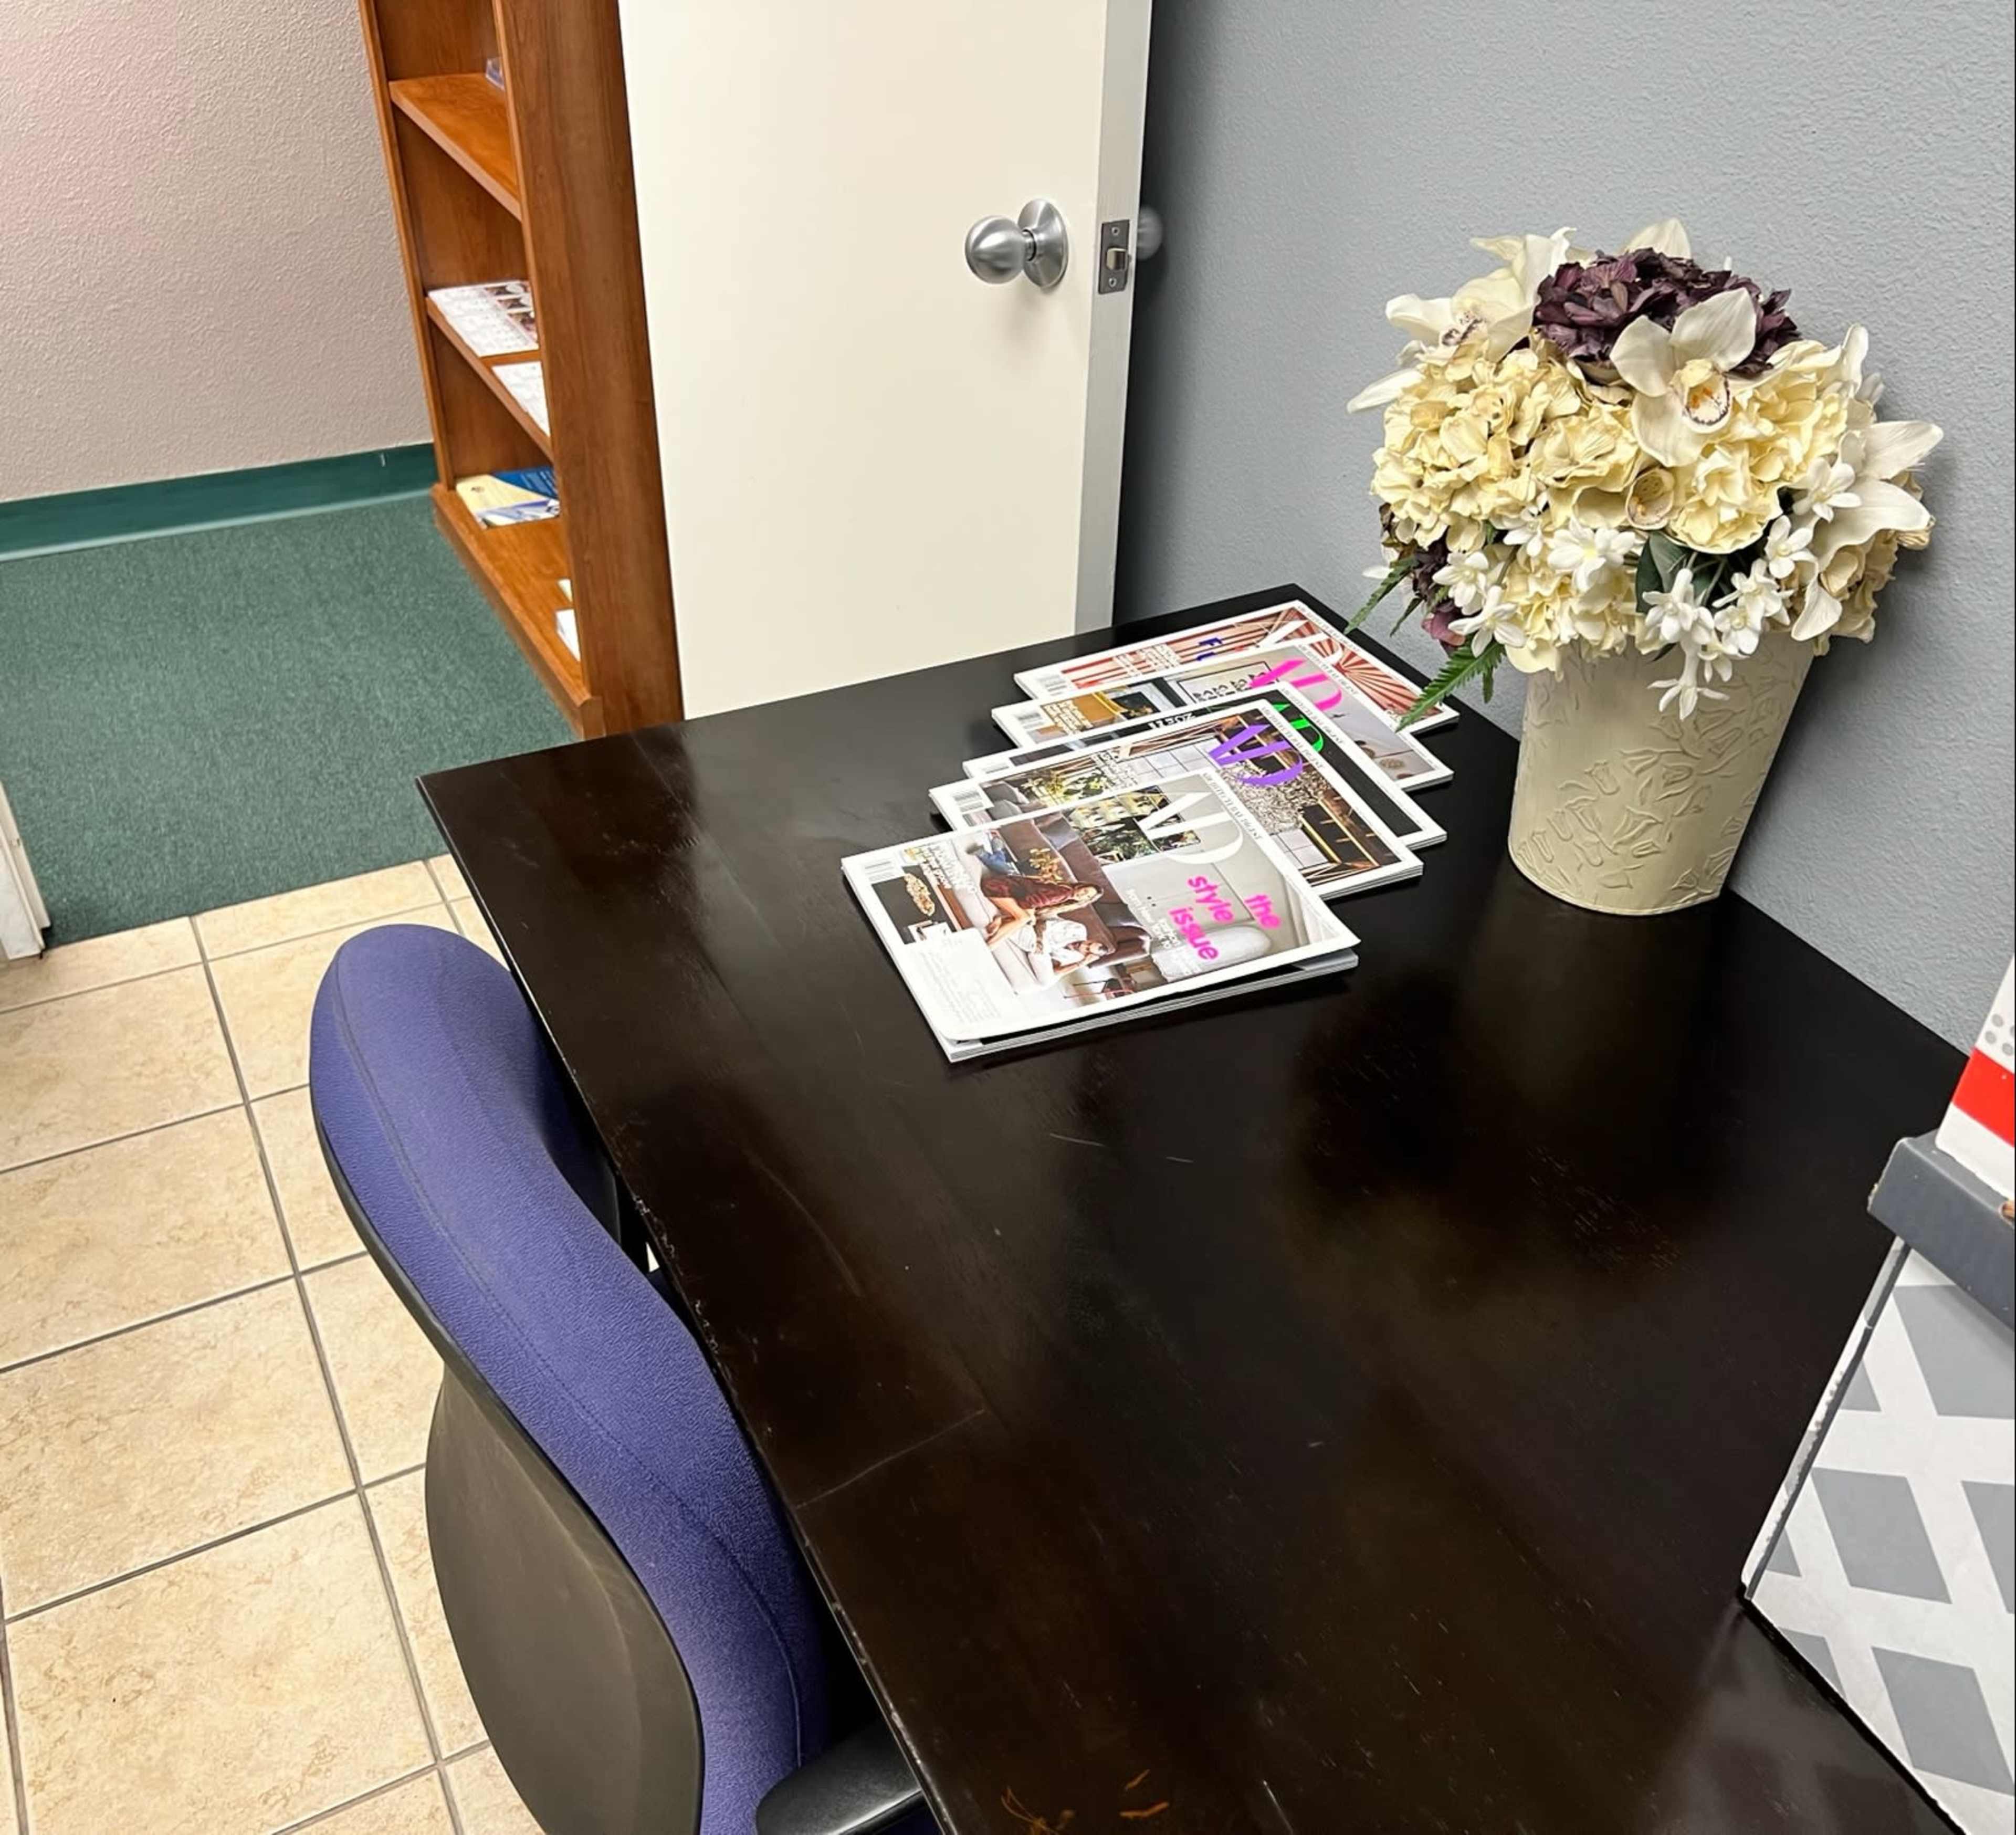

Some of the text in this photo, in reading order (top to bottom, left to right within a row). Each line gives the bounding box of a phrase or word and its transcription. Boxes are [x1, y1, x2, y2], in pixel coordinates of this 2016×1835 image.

[1208, 723, 1304, 788] AD
[1122, 792, 1243, 863] AD
[1188, 876, 1233, 922] style
[1244, 894, 1280, 929] the
[1169, 907, 1219, 960] issue
